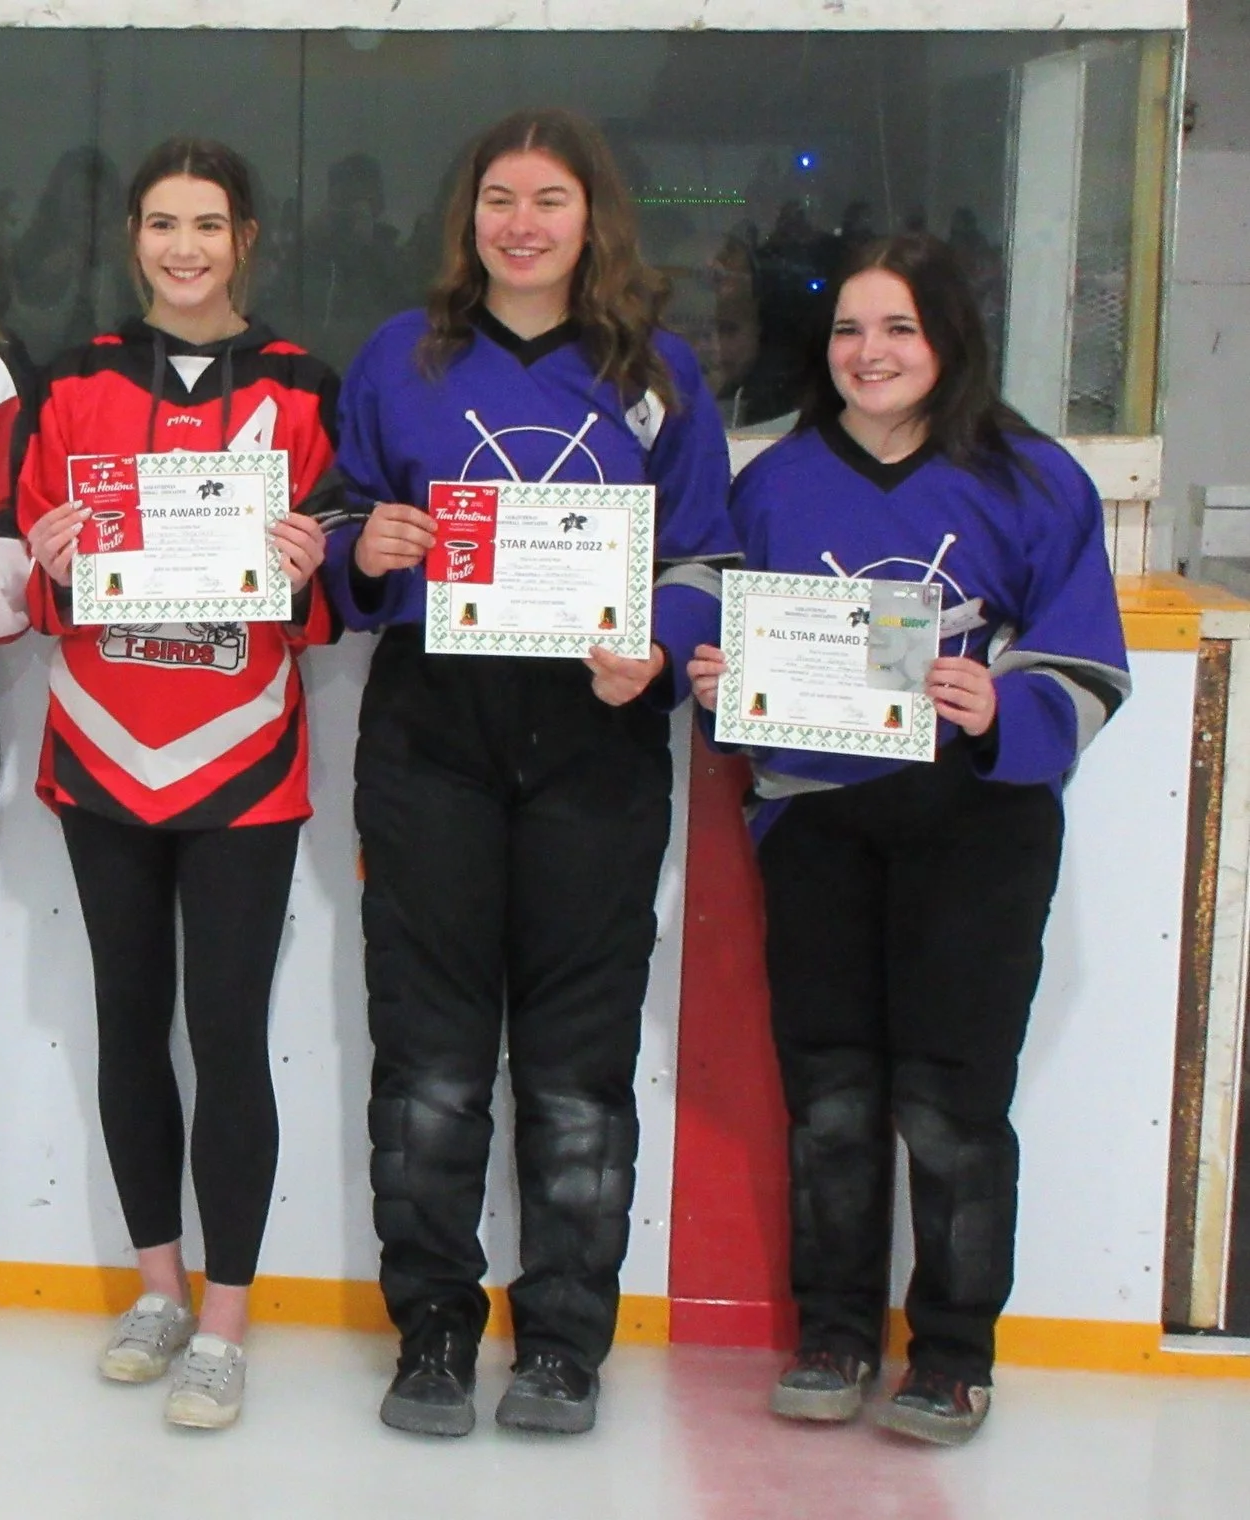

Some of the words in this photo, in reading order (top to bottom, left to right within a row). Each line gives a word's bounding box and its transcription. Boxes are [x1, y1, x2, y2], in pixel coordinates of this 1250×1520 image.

[166, 414, 203, 427] MNM
[227, 394, 278, 452] A
[80, 481, 96, 494] Tim
[97, 480, 136, 493] Hortons
[141, 508, 167, 518] STAR
[169, 508, 212, 517] AWARD
[214, 506, 240, 517] 2022
[435, 508, 454, 521] Tim
[454, 508, 493, 522] Hortons
[499, 539, 527, 549] STAR
[529, 540, 573, 550] AWARD
[575, 540, 603, 551] 2022
[768, 629, 788, 640] ALL
[790, 630, 816, 642] STAR
[818, 633, 860, 645] AWARD
[124, 637, 216, 665] T-BIRDS
